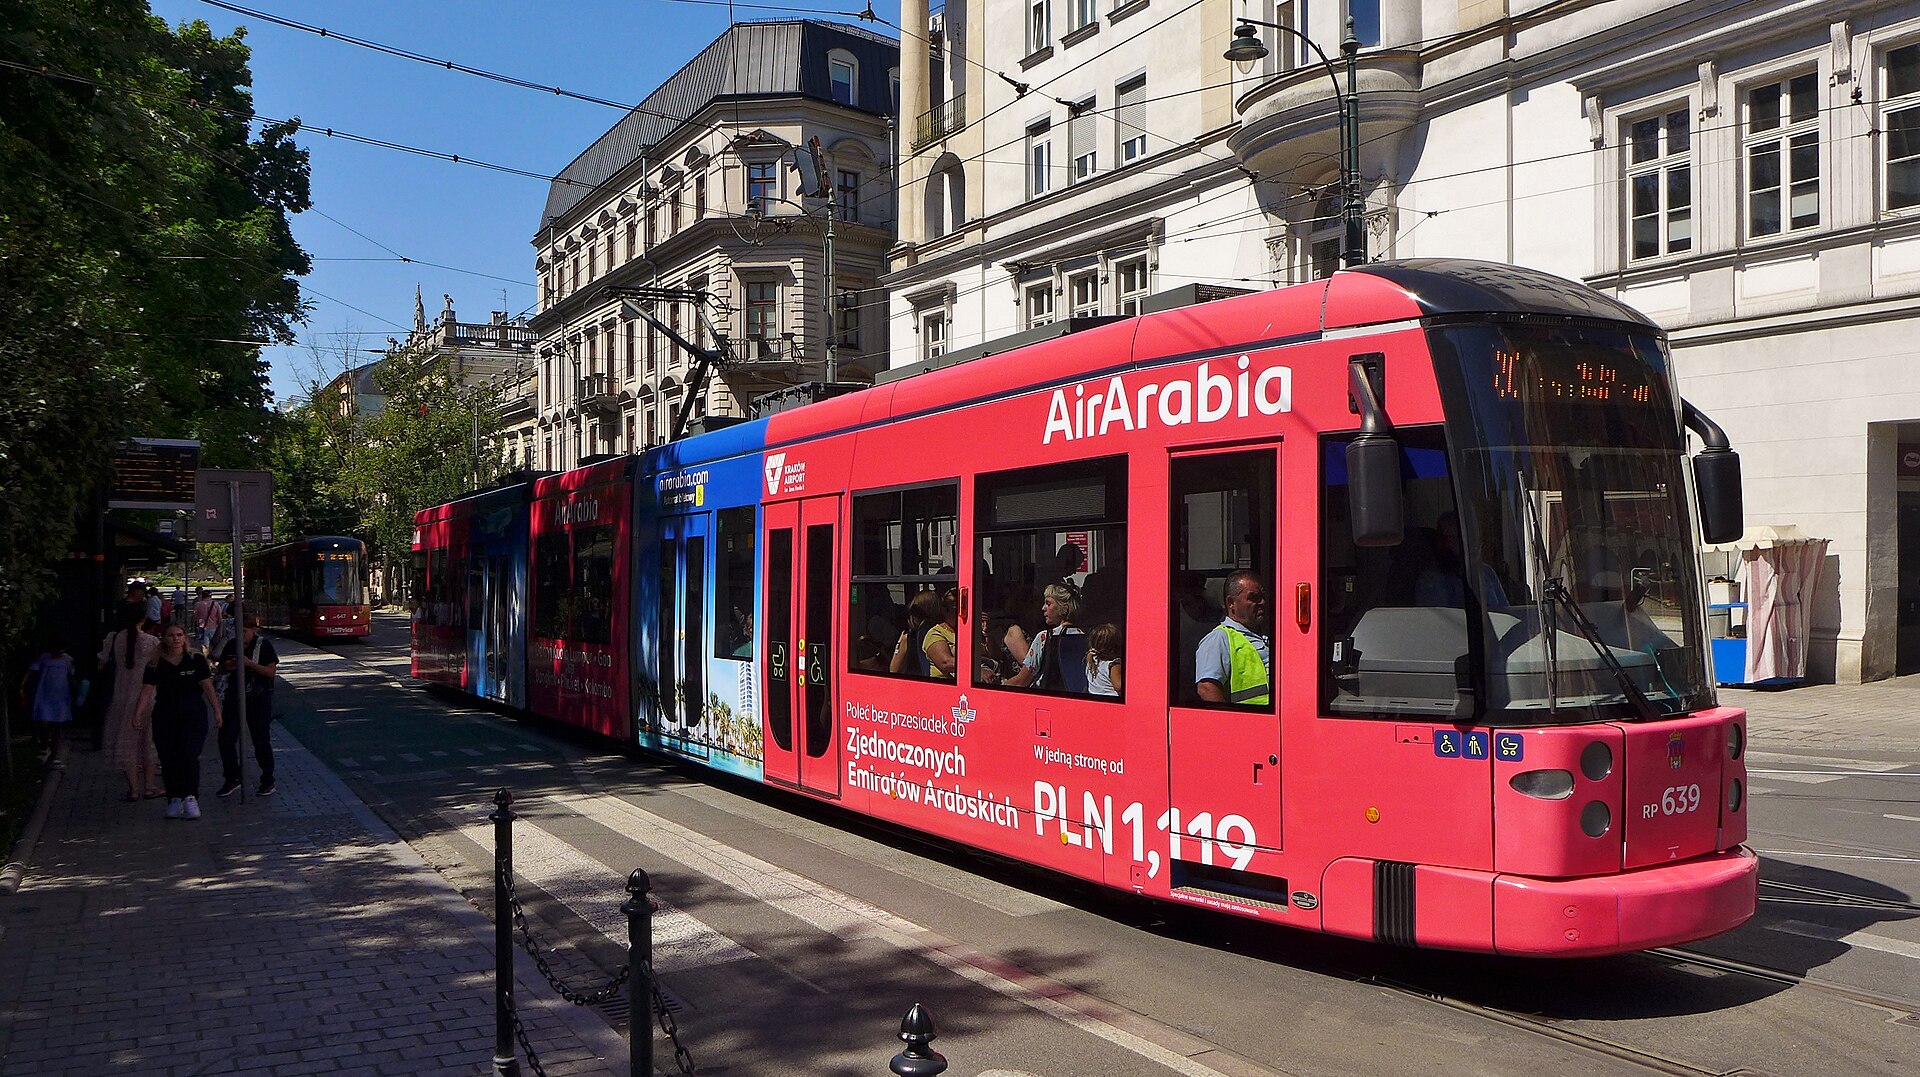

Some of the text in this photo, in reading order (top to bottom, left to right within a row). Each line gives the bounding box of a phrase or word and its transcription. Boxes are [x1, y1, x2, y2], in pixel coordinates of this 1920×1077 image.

[1042, 355, 1292, 445] AirArabia
[659, 469, 709, 491] airarabia.com
[784, 461, 806, 475] KRAKÓW
[784, 473, 806, 485] AIRPORT
[554, 494, 598, 527] AirArabia
[597, 649, 612, 667] Goa
[846, 701, 966, 738] Poleć bez przesiadek do
[846, 726, 966, 778] Zjednoczonych
[1033, 744, 1124, 776] W jedną stronę od
[847, 760, 1019, 830] Emiratów Arabskich
[1642, 783, 1701, 819] RP 639
[1033, 780, 1257, 880] PLN 1,119
